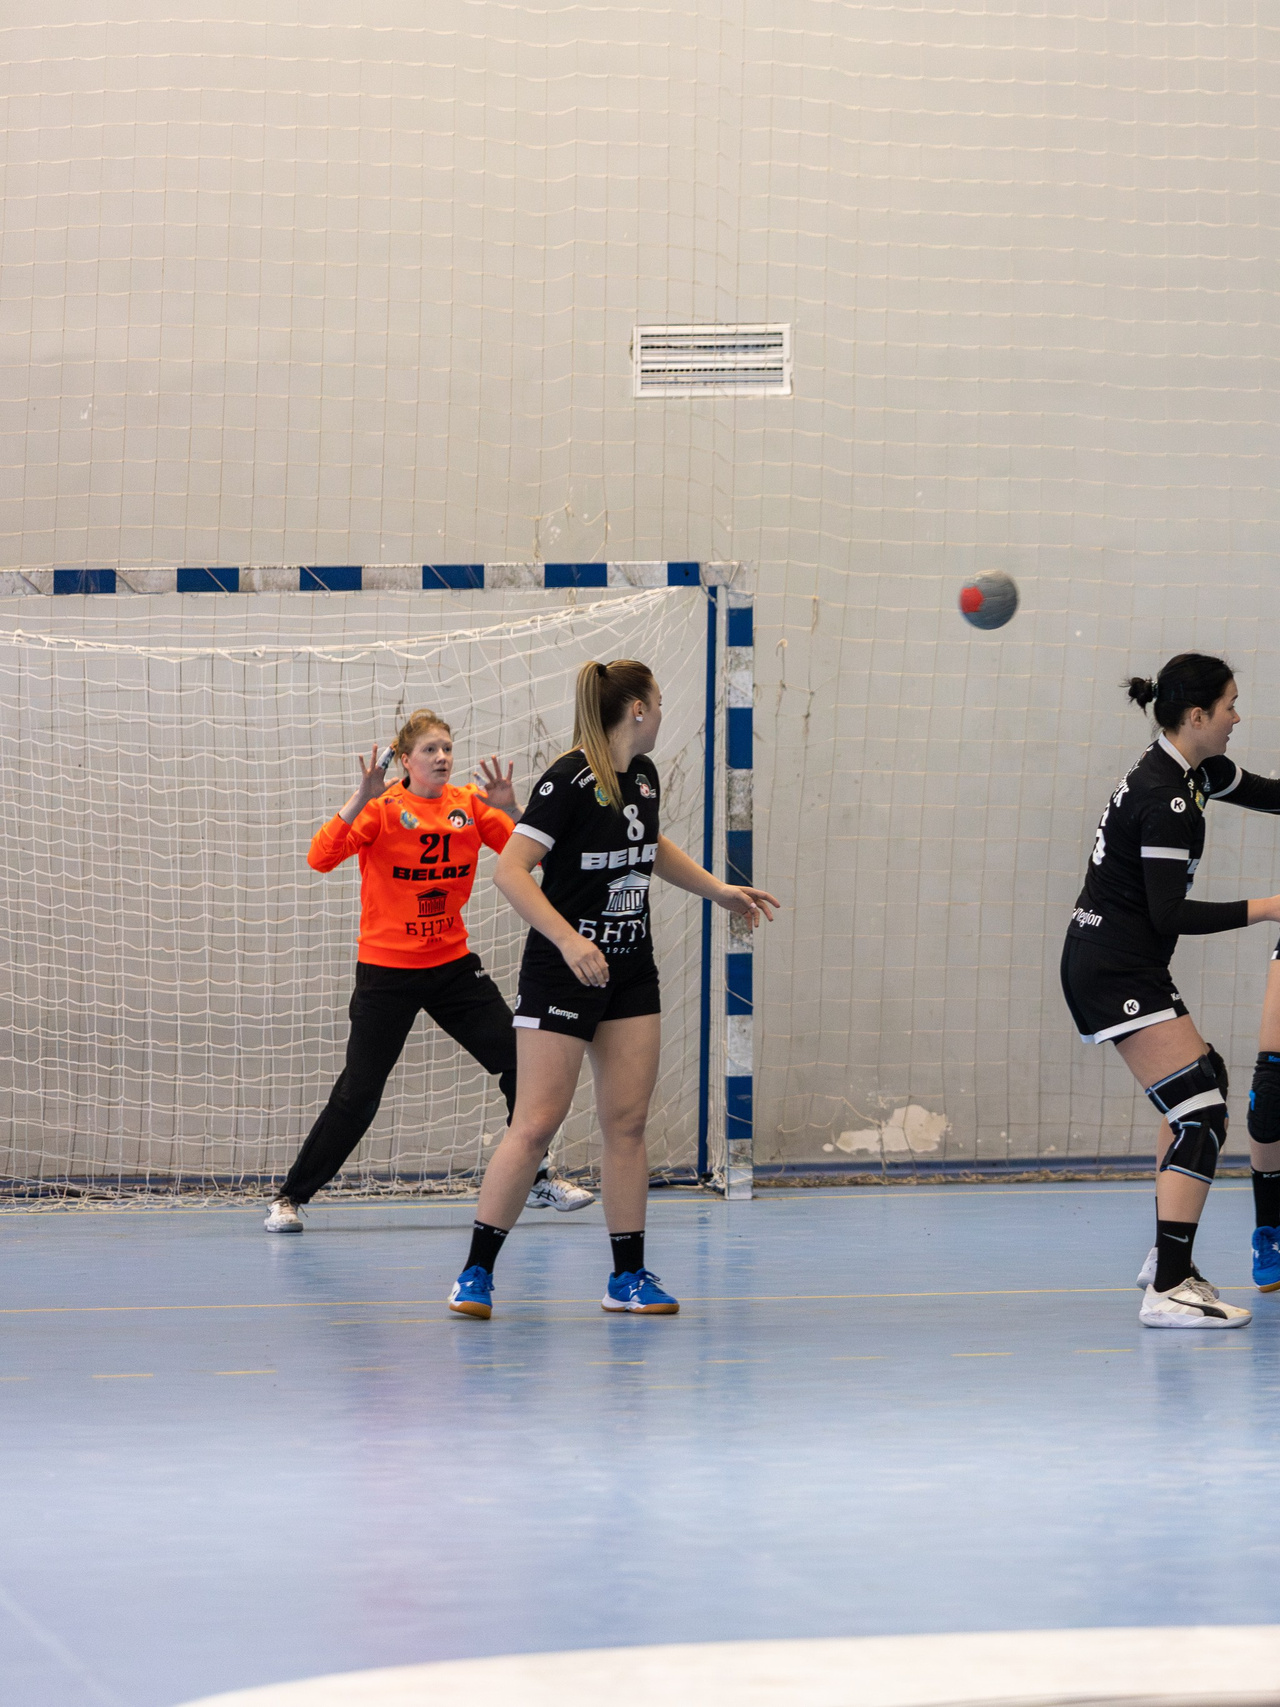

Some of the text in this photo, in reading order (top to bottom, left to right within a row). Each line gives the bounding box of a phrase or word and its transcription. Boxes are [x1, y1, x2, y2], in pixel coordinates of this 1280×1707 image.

[578, 772, 596, 789] Kemp
[623, 804, 645, 841] 8
[419, 833, 452, 864] 21
[581, 843, 658, 870] BELA
[392, 864, 470, 881] BELAZ
[405, 916, 455, 937] БНТУ
[578, 912, 648, 943] БНТУ
[548, 1005, 579, 1020] Kempa
